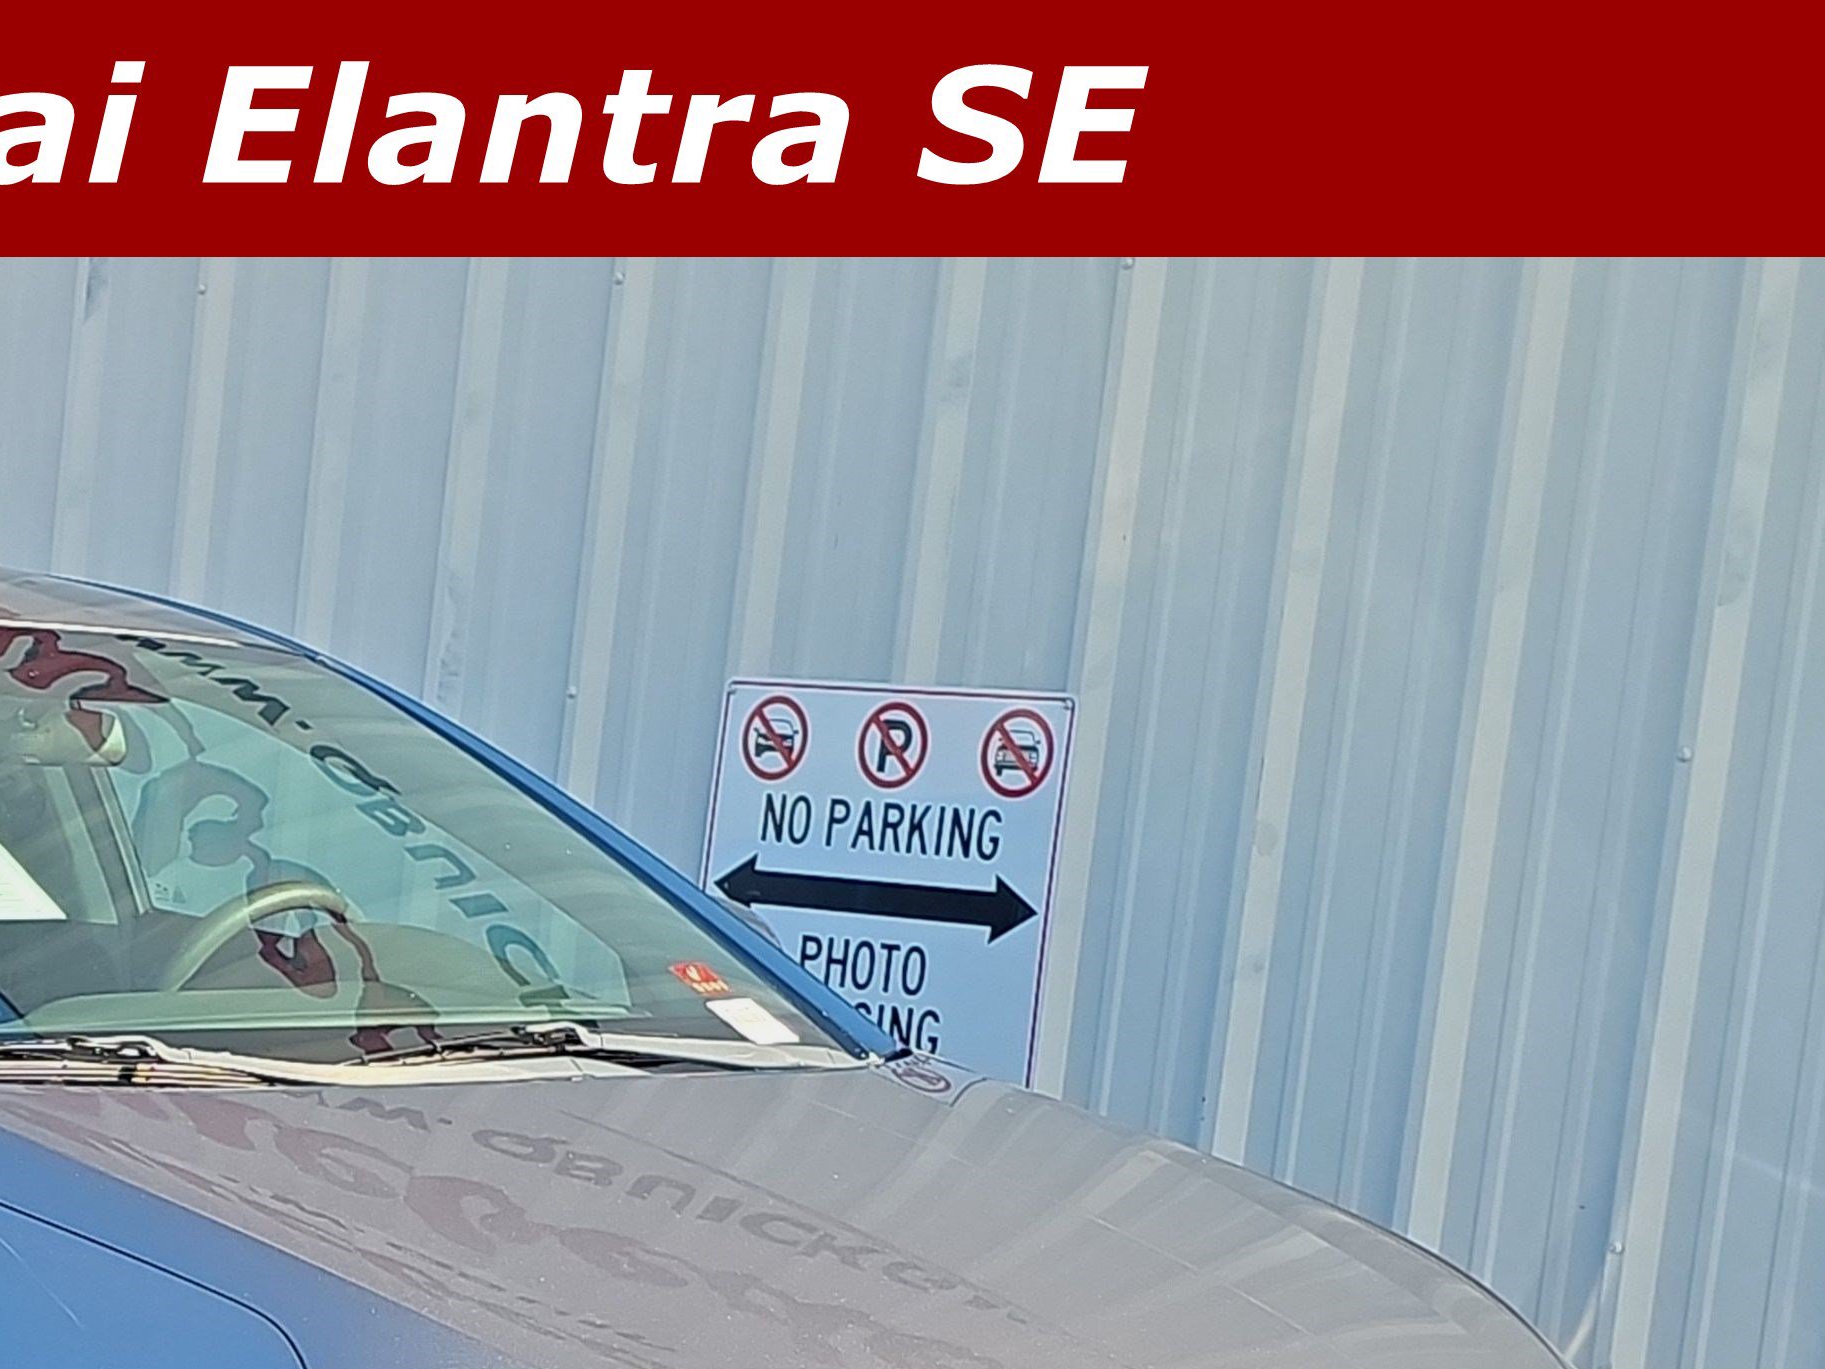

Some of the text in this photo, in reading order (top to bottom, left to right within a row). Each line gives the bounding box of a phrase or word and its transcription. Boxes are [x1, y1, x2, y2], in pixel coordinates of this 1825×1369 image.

[760, 793, 1003, 861] NO PARKING
[800, 935, 927, 997] PHOTO
